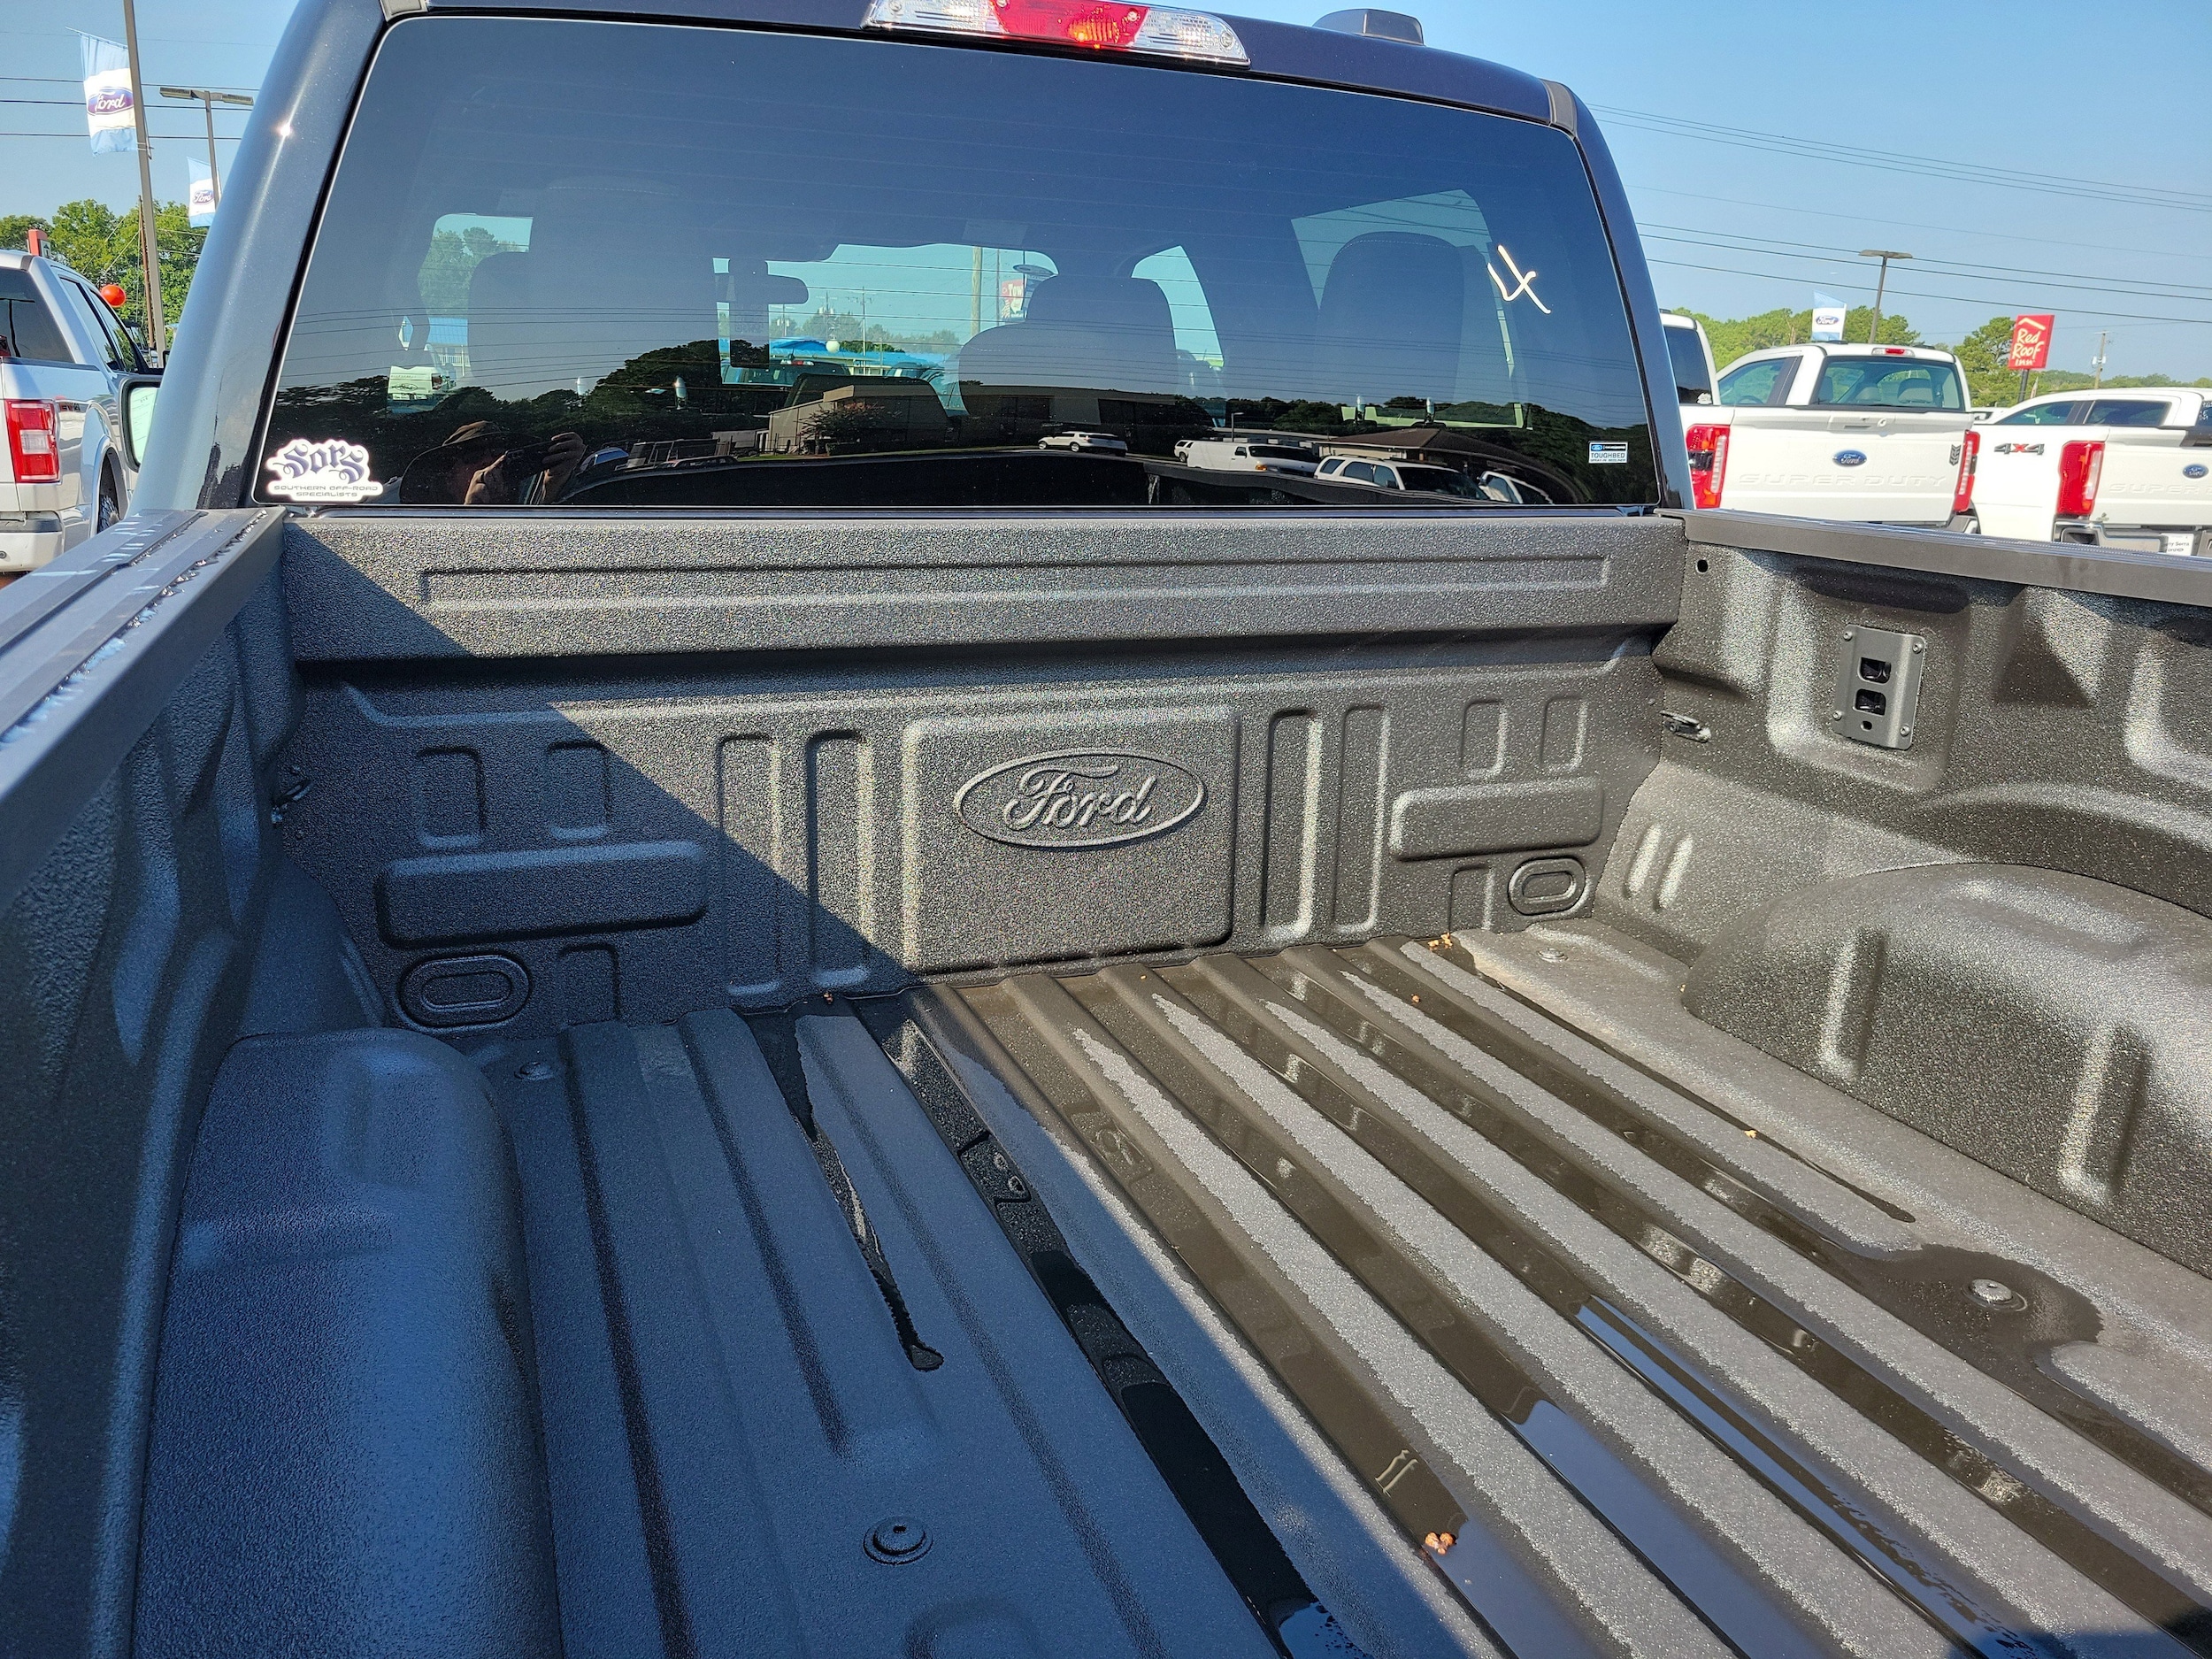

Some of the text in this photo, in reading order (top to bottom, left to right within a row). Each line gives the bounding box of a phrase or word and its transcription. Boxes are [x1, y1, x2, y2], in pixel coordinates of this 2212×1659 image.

[95, 90, 126, 111] Ford
[193, 189, 213, 204] Ford
[2017, 328, 2041, 343] Red
[2012, 342, 2045, 359] Roof
[1739, 472, 1947, 487] SUPER DUTY
[1003, 764, 1156, 831] Ford
